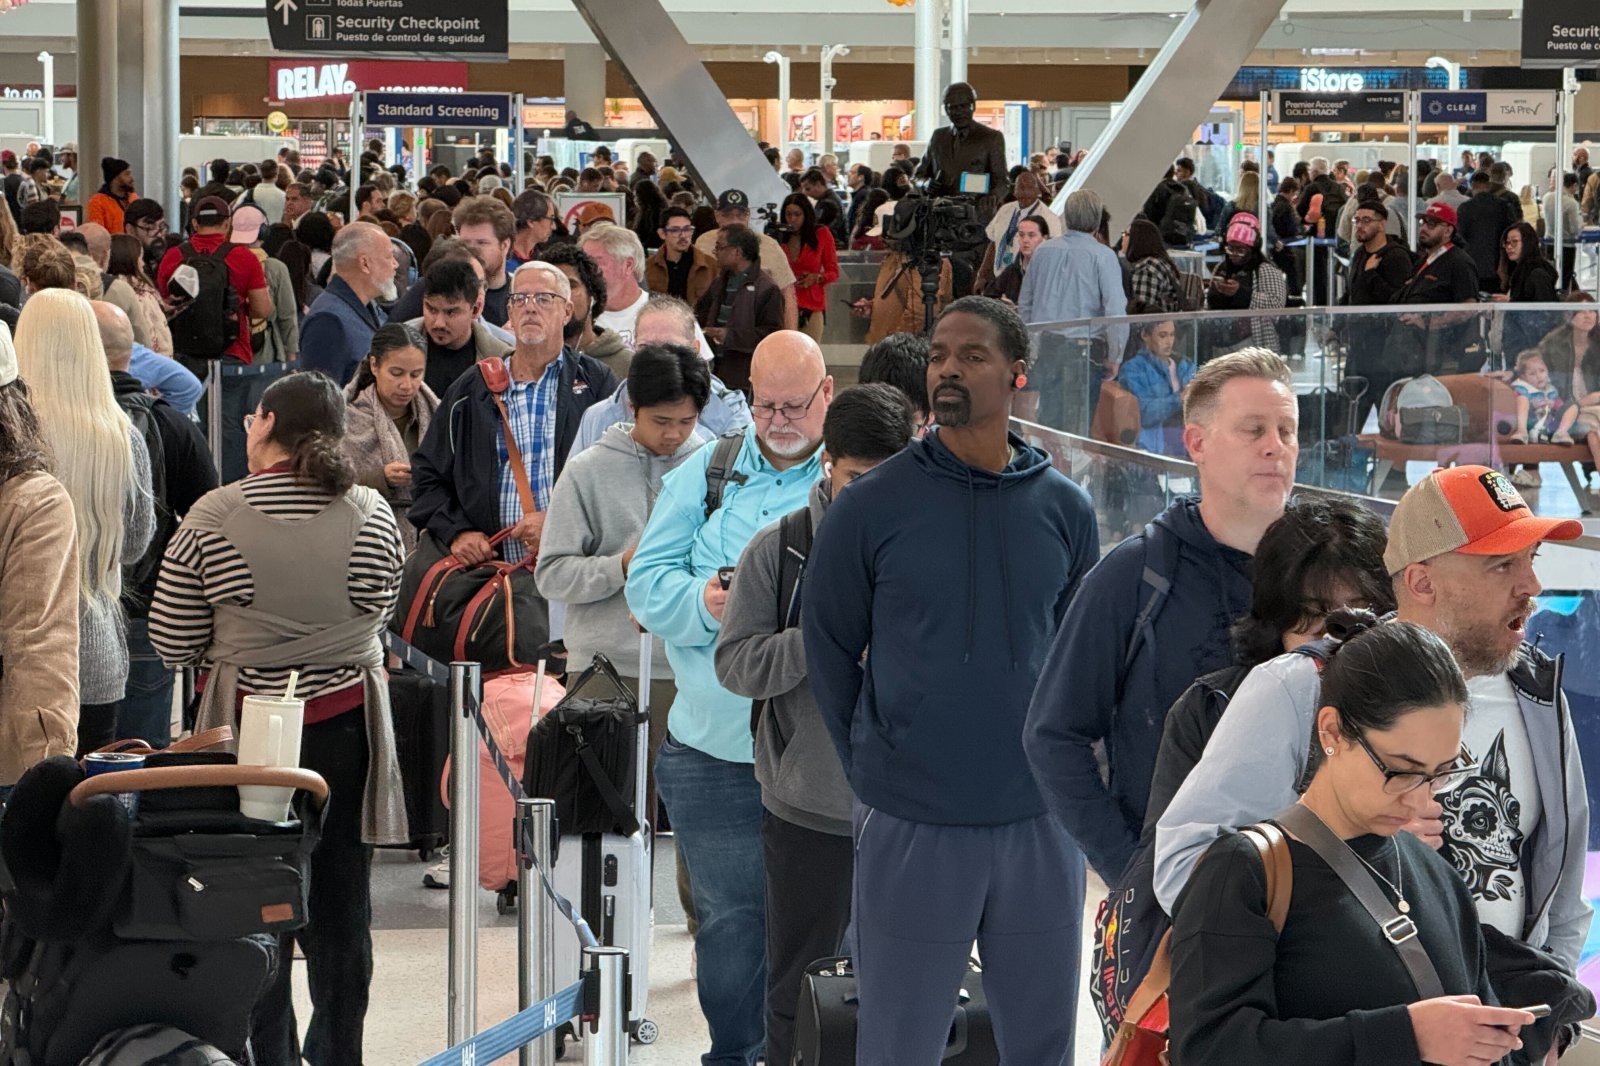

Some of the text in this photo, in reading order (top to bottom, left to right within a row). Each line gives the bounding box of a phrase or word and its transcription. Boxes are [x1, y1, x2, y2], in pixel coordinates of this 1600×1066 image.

[336, 15, 480, 32] Security Checkpoint
[336, 33, 485, 44] Puesto de control de seguridad
[1552, 25, 1600, 39] Securit
[1547, 41, 1578, 50] Puesto
[1580, 41, 1592, 50] de
[1300, 68, 1364, 92] iStore
[4, 86, 20, 98] to
[1285, 101, 1315, 109] Premier
[1500, 105, 1516, 114] TSA
[377, 104, 499, 120] Standard Screening
[1121, 888, 1135, 1009] ACING
